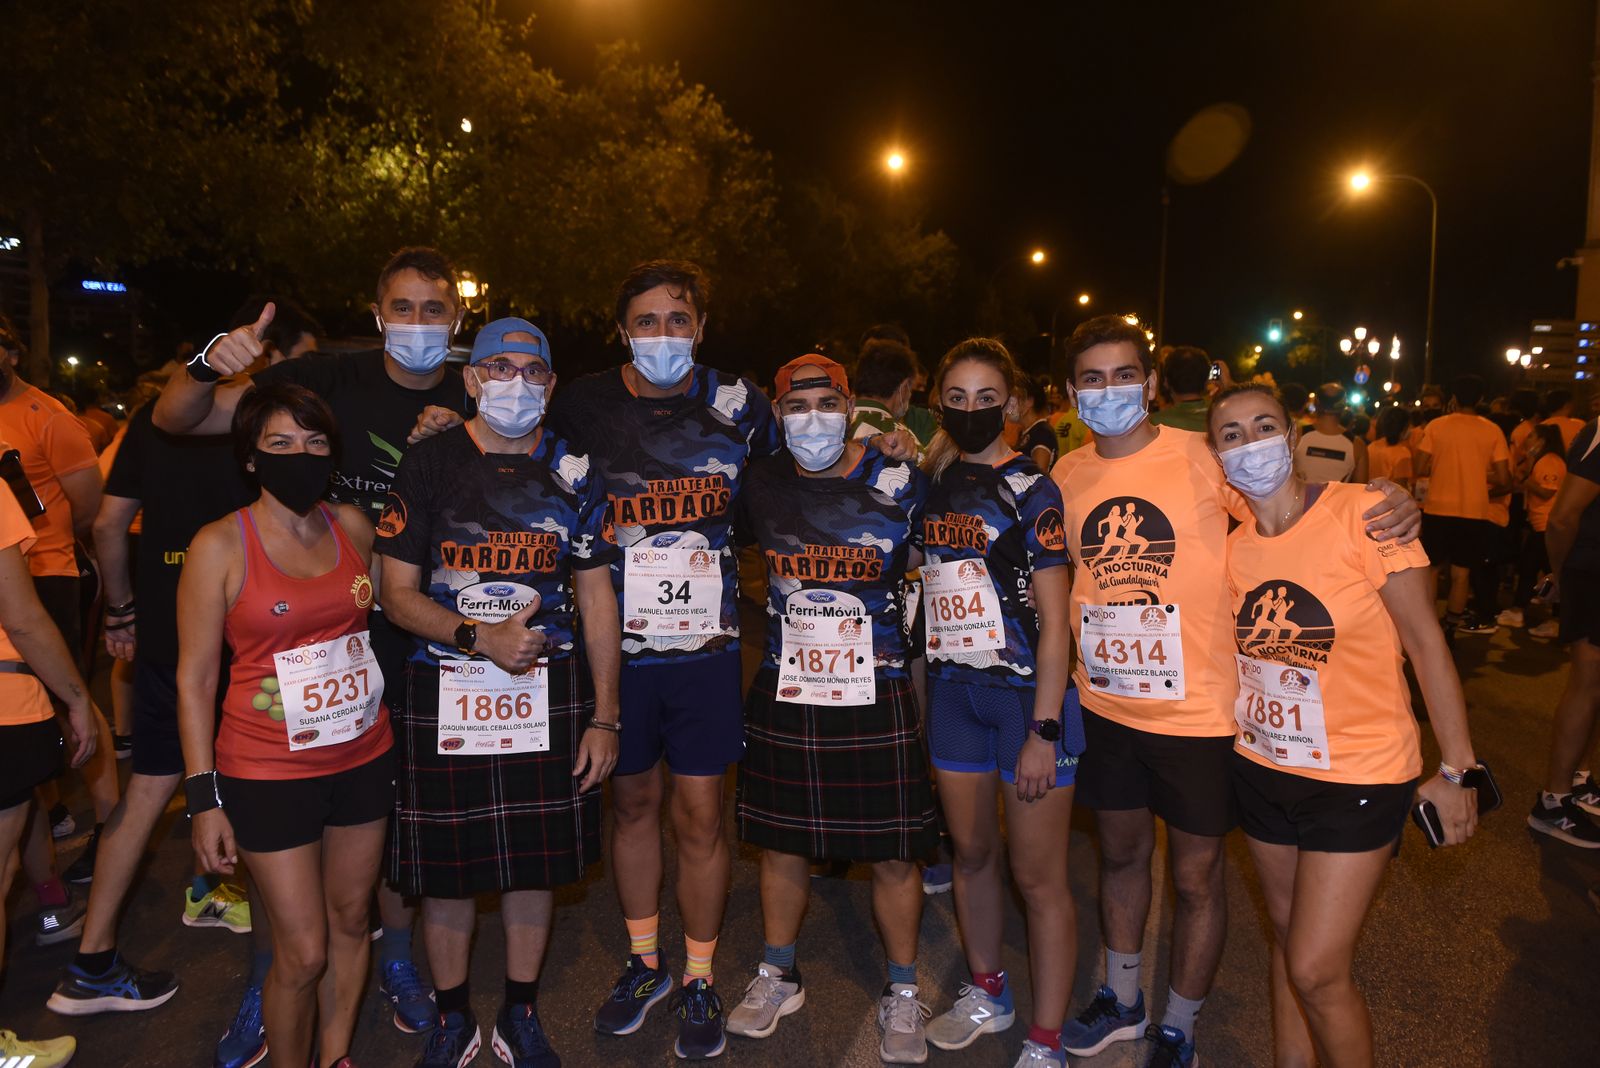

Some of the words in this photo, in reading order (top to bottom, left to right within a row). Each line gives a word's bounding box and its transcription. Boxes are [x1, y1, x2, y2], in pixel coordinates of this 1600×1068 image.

[649, 477, 722, 493] TRAILTEAM
[489, 533, 556, 546] TRAILTEAM
[927, 521, 988, 552] ARDAOS
[164, 547, 190, 565] un
[442, 547, 558, 571] VARDAOS
[806, 546, 875, 559] TRAILTEAM
[1092, 569, 1103, 580] LA
[1104, 561, 1168, 580] NOCTURNA
[489, 586, 510, 595] Ford
[1098, 580, 1109, 591] del
[1110, 574, 1160, 589] Guadalquivir
[657, 580, 692, 605] 34
[811, 592, 831, 602] Ford
[638, 607, 664, 615] MANUEL
[789, 603, 861, 619] Ferri-Móvil
[930, 591, 985, 622] 1884
[1095, 638, 1167, 665] 4314
[1258, 645, 1328, 664] NOCTURNA
[795, 647, 855, 674] 1871
[799, 676, 825, 684] DOMINGO
[850, 676, 872, 684] REYES
[1150, 669, 1178, 678] BLANCO
[303, 668, 369, 713] 5237
[456, 692, 532, 722] 1866
[1246, 692, 1302, 732] 1881
[299, 714, 331, 725] SUSANA
[490, 723, 522, 731] CEBALLOS
[523, 721, 547, 729] SOLANO
